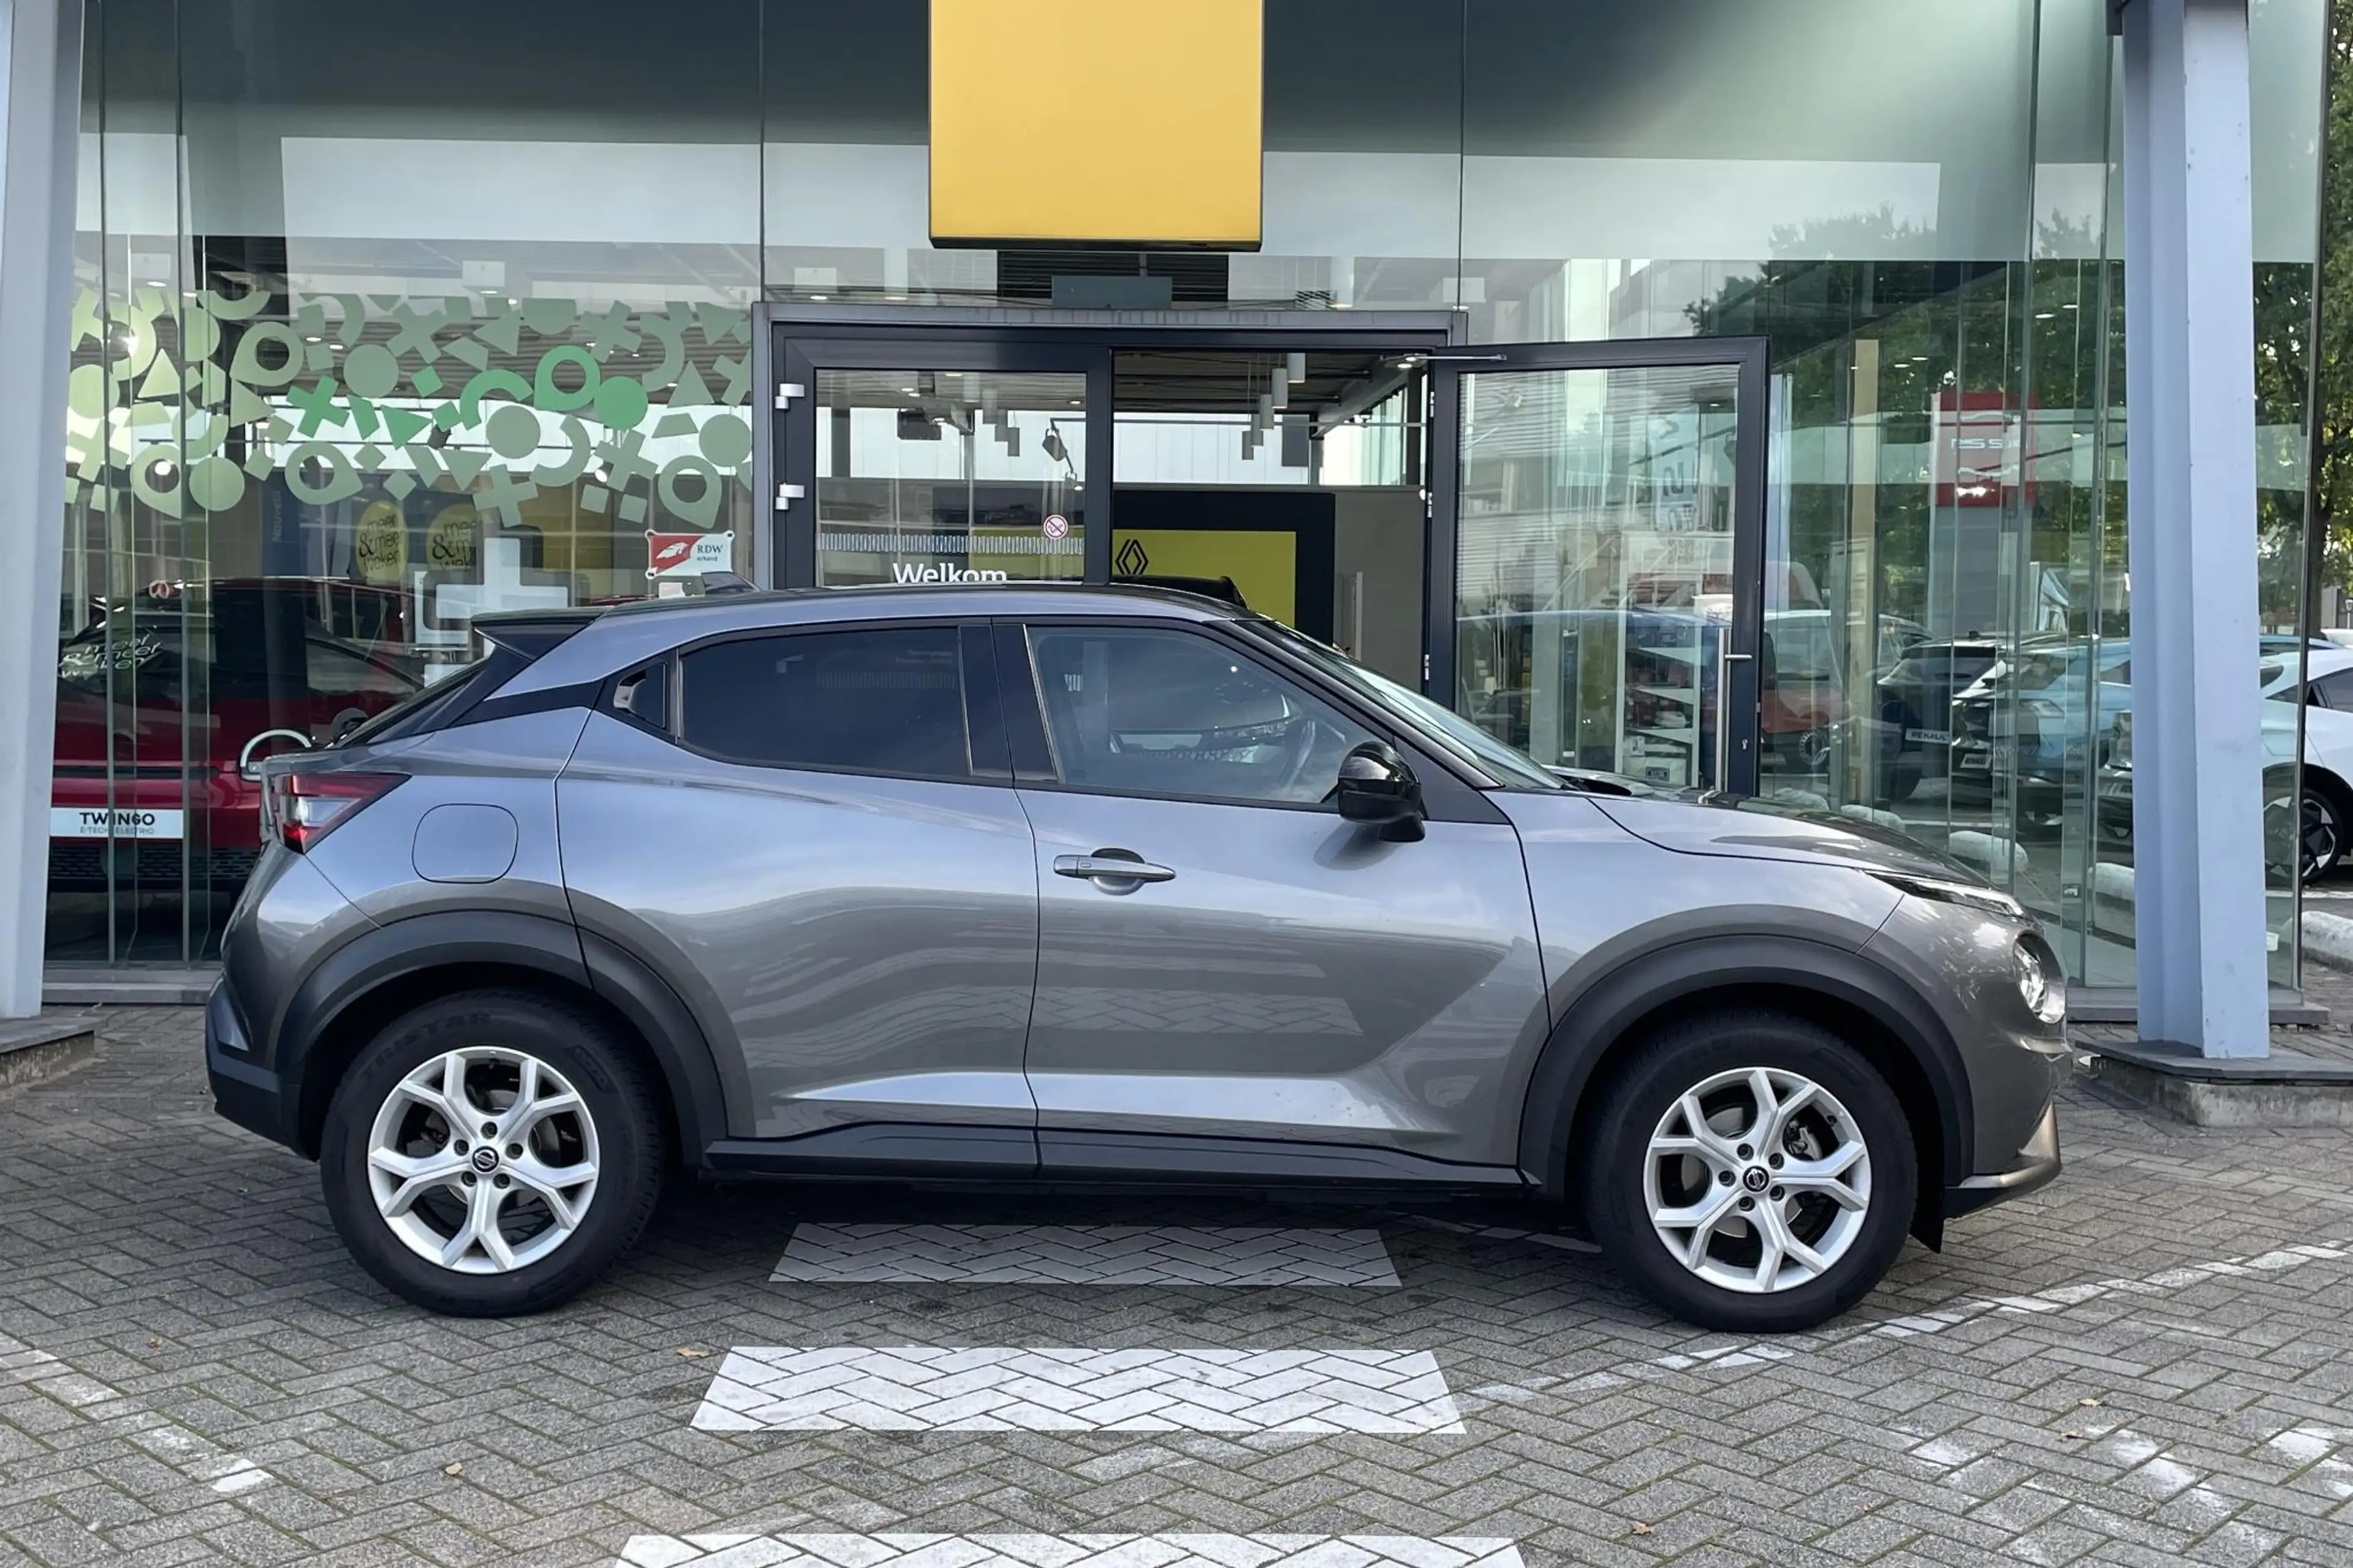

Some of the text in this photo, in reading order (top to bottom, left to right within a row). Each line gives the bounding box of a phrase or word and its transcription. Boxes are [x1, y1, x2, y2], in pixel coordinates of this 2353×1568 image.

[697, 544, 723, 553] RDW
[892, 562, 1007, 583] Welkom
[79, 812, 156, 826] TWINGO
